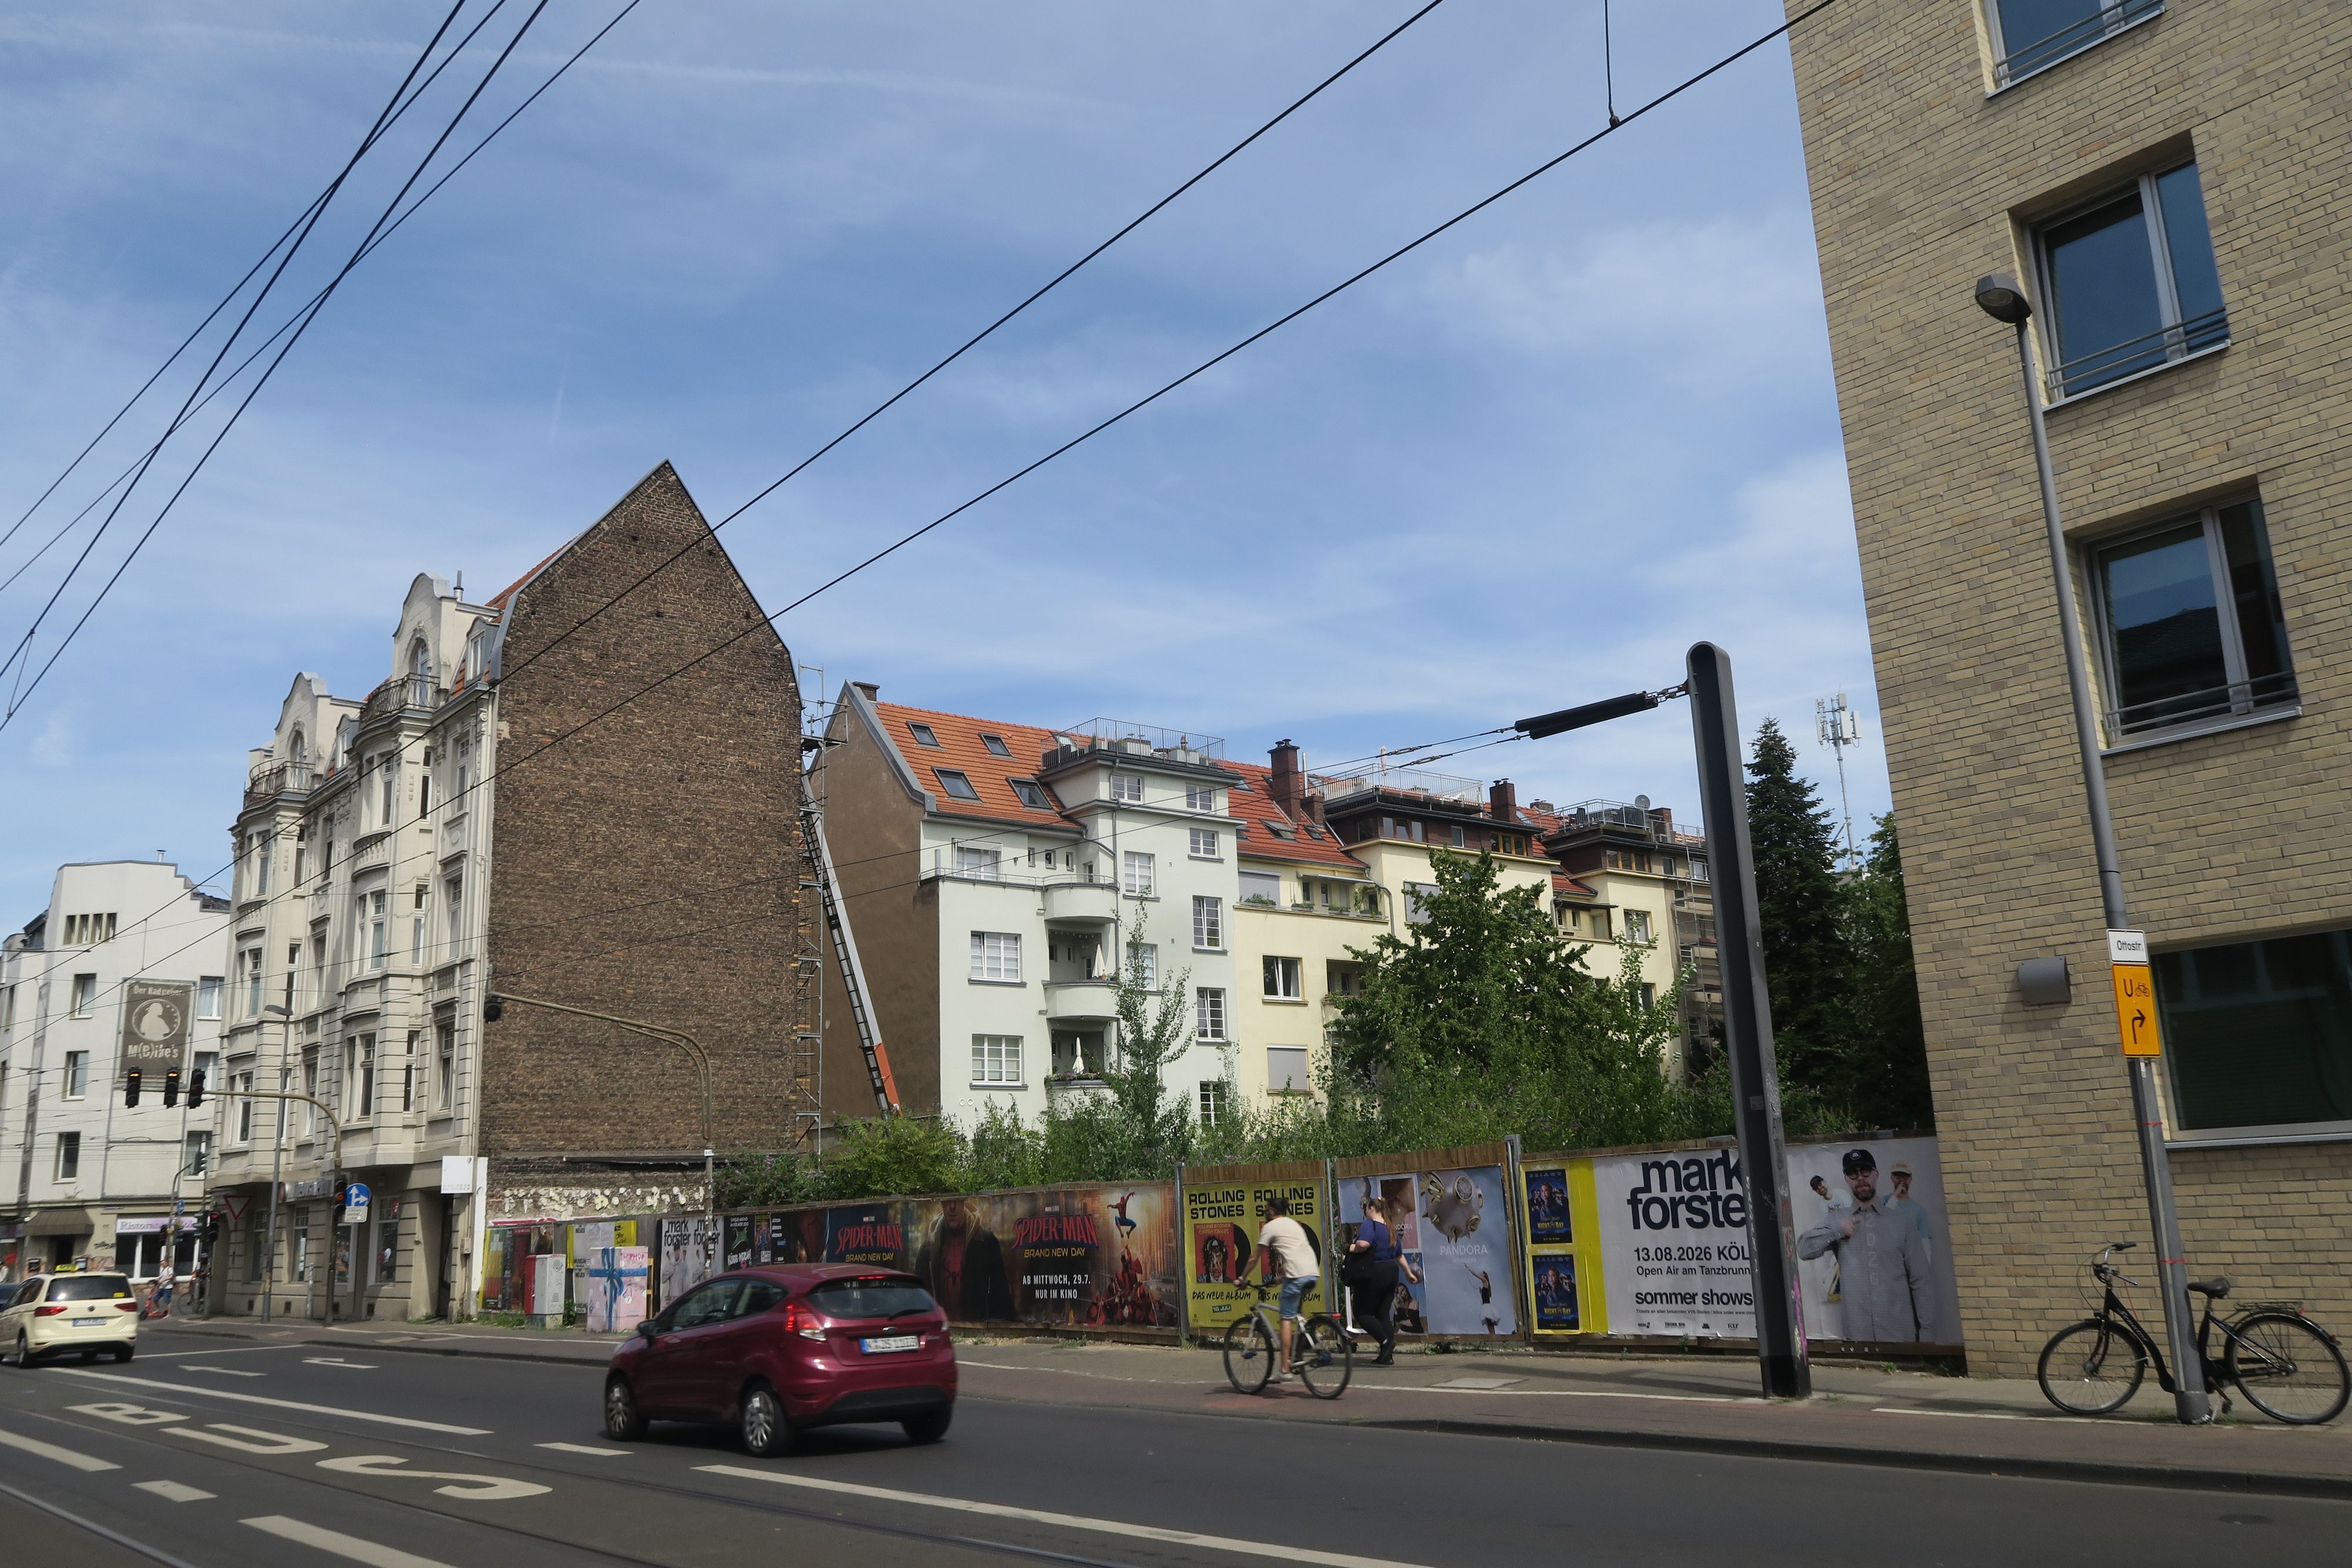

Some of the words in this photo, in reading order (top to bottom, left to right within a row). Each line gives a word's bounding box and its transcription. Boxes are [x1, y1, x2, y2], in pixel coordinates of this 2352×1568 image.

[2117, 940, 2144, 951] Ottostr.
[2123, 978, 2133, 997] U
[1642, 1149, 1743, 1192] mark
[1188, 1189, 1245, 1205] ROLLING
[1254, 1187, 1314, 1202] ROLLING
[1191, 1205, 1245, 1219] STONES
[1255, 1202, 1314, 1217] SNES
[1627, 1187, 1747, 1229] forste
[668, 1218, 689, 1233] mark
[697, 1216, 717, 1231] mk
[664, 1231, 691, 1246] forster
[694, 1229, 720, 1245] forer
[835, 1223, 904, 1255] SPIDER-MAN
[1011, 1214, 1099, 1249] SPIDER-MAN
[846, 1254, 867, 1262] BRAND
[883, 1252, 894, 1261] DAY
[1024, 1249, 1050, 1258] BRAND
[1052, 1248, 1068, 1257] NEW
[1071, 1248, 1085, 1256] DAY
[1440, 1245, 1488, 1256] PANDORA
[1634, 1246, 1712, 1261] 13.08.2026
[1718, 1242, 1750, 1261] KÖL
[1636, 1266, 1662, 1278] Open
[1666, 1266, 1679, 1275] Air
[1699, 1265, 1750, 1275] Tanzbrunn
[1023, 1275, 1031, 1285] AB
[1034, 1275, 1070, 1286] MITTWOCH,
[1073, 1275, 1091, 1284] 29.7.
[1035, 1289, 1048, 1299] NUR
[1050, 1289, 1057, 1299] IM
[1060, 1289, 1077, 1299] KINO
[1192, 1291, 1205, 1300] DAS
[1207, 1291, 1224, 1300] NEUE
[1226, 1291, 1251, 1300] ALBUM
[1258, 1292, 1270, 1300] DS
[1635, 1292, 1698, 1305] sommer
[1702, 1289, 1753, 1305] shows
[64, 1403, 553, 1500] BUS
